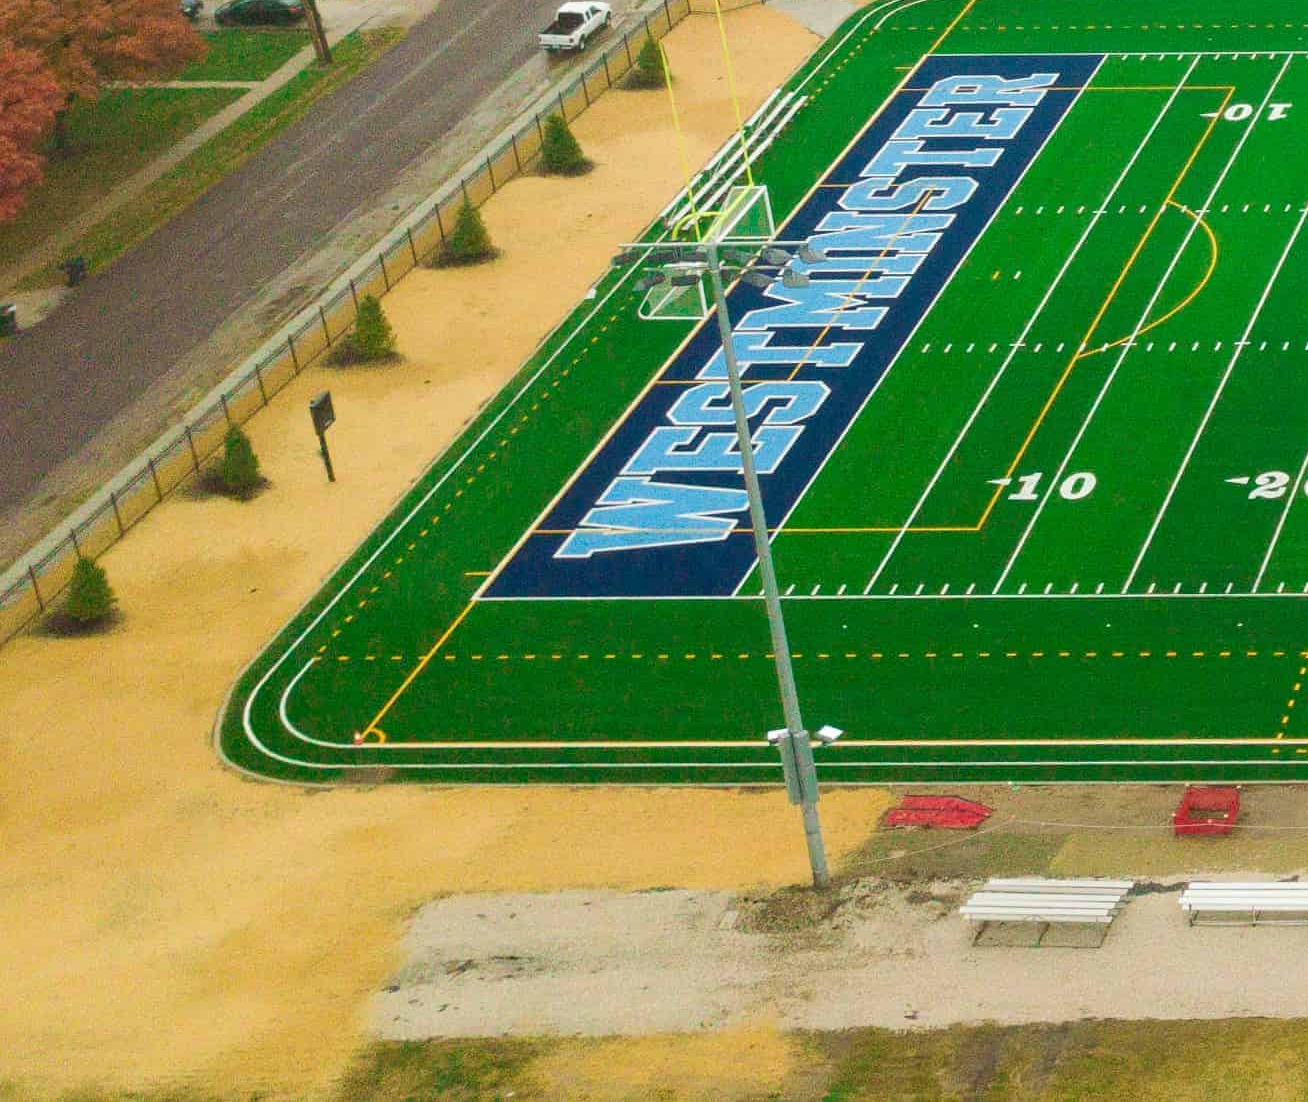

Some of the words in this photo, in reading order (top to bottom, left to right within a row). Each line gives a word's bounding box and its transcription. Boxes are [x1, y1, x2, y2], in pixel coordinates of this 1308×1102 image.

[1224, 103, 1292, 121] 10
[553, 72, 1060, 559] WESTMINSTER
[1007, 472, 1097, 500] 10
